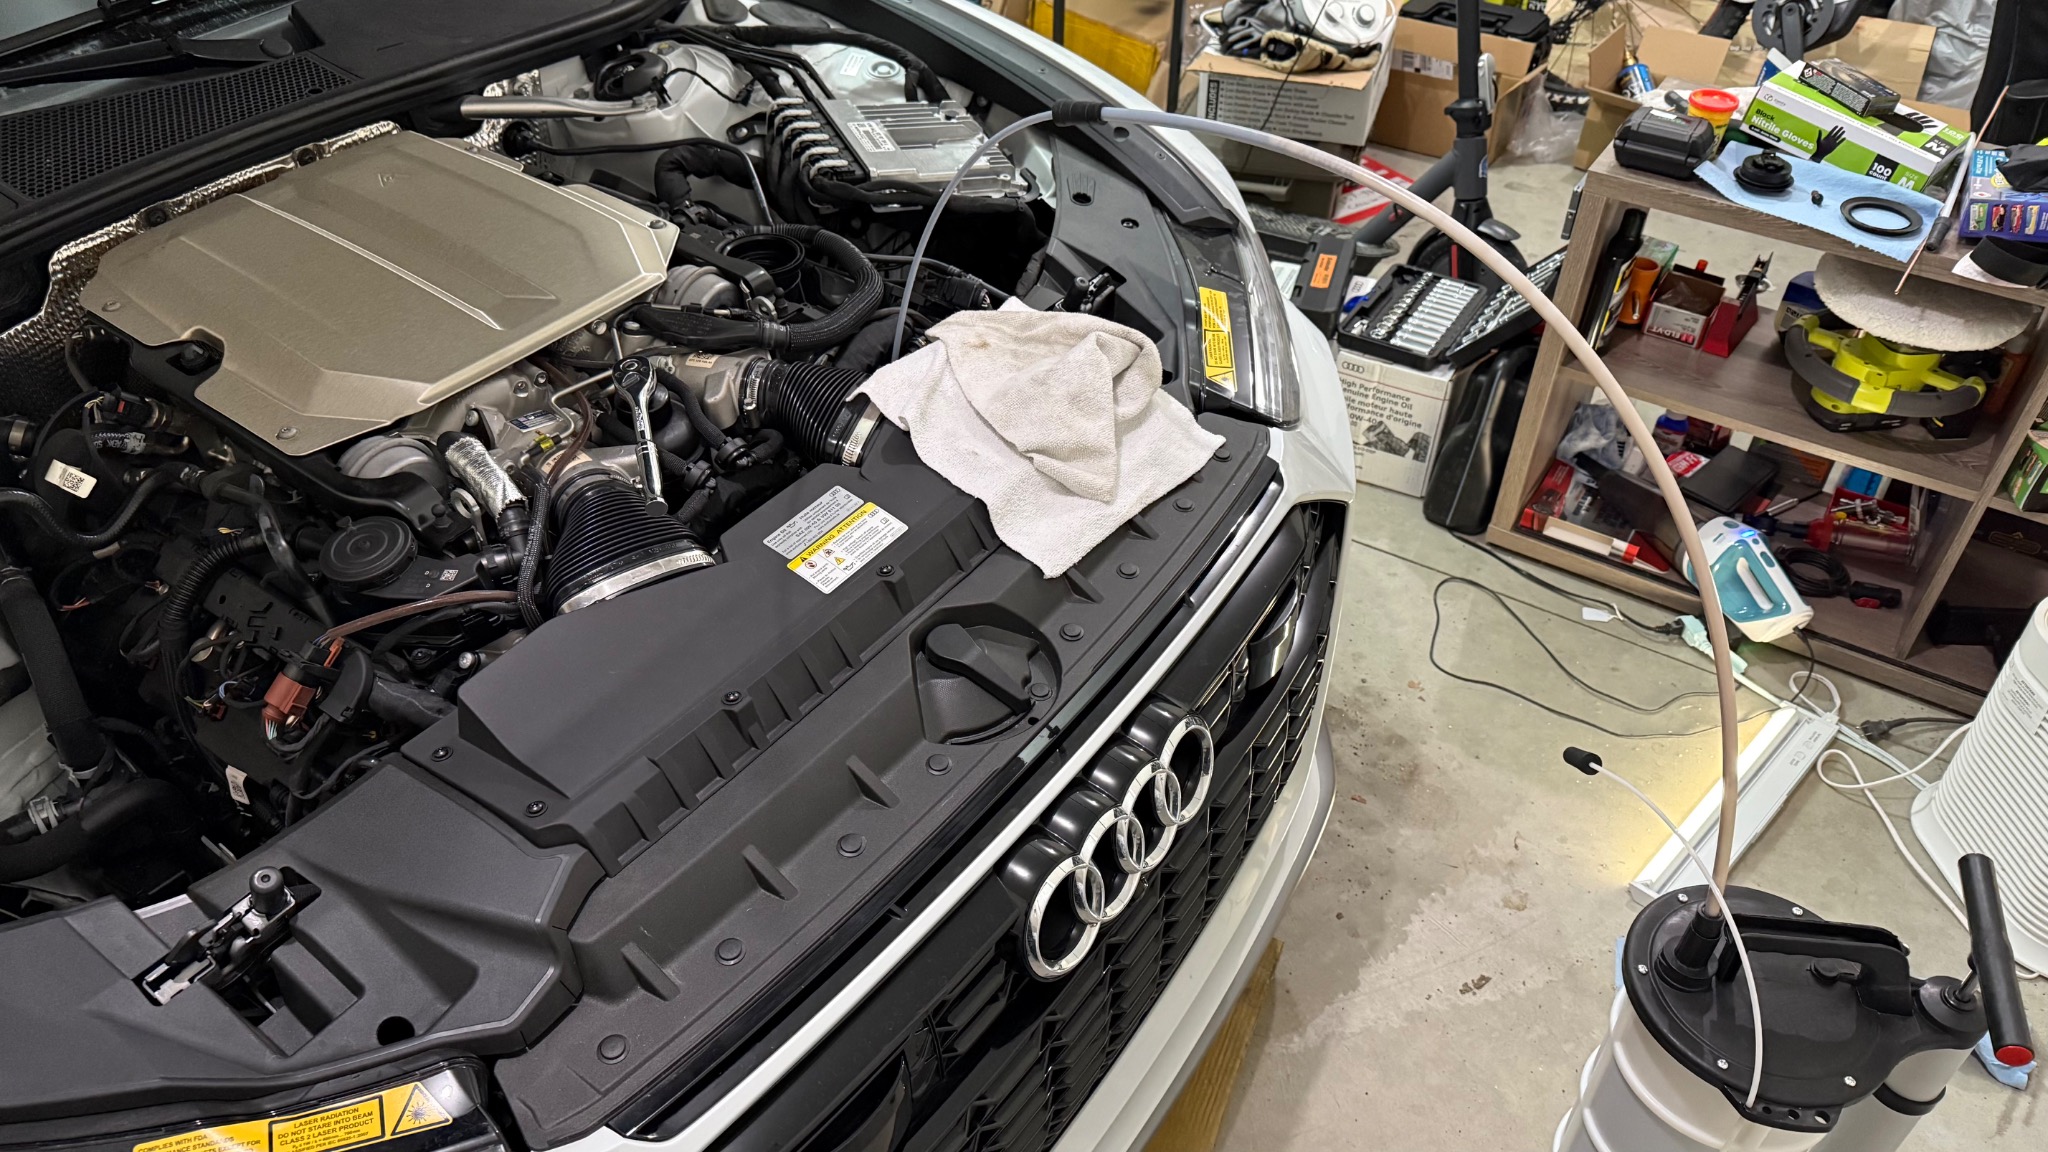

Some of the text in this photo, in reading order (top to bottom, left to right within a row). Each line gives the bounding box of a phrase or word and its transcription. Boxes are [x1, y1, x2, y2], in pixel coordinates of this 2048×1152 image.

[1207, 81, 1219, 119] NCLUDES
[1755, 108, 1776, 121] Black
[1751, 115, 1780, 134] Nitrile
[1782, 129, 1815, 150] Gloves
[1925, 141, 1948, 156] M
[1868, 170, 1888, 181] count
[1872, 162, 1892, 177] 100
[1905, 171, 1919, 180] SIZE
[1897, 176, 1915, 190] M
[1343, 387, 1413, 411] enuine Engine Oil
[1359, 383, 1411, 403] Performance
[1357, 401, 1388, 412] moteur
[1389, 407, 1413, 419] haute
[1386, 411, 1422, 429] d'origine
[806, 534, 836, 556] WARNING
[836, 509, 867, 534] ATTENTION
[291, 1128, 307, 1137] NOT
[308, 1121, 332, 1132] STARE
[334, 1117, 351, 1126] INTO
[352, 1111, 373, 1121] BEAM
[294, 1107, 359, 1129] LASER RADIATION
[280, 1136, 305, 1146] CLASS
[312, 1127, 337, 1139] LASER
[339, 1118, 374, 1132] PRODUCT
[175, 1137, 192, 1146] WITH
[246, 1139, 261, 1147] FOR
